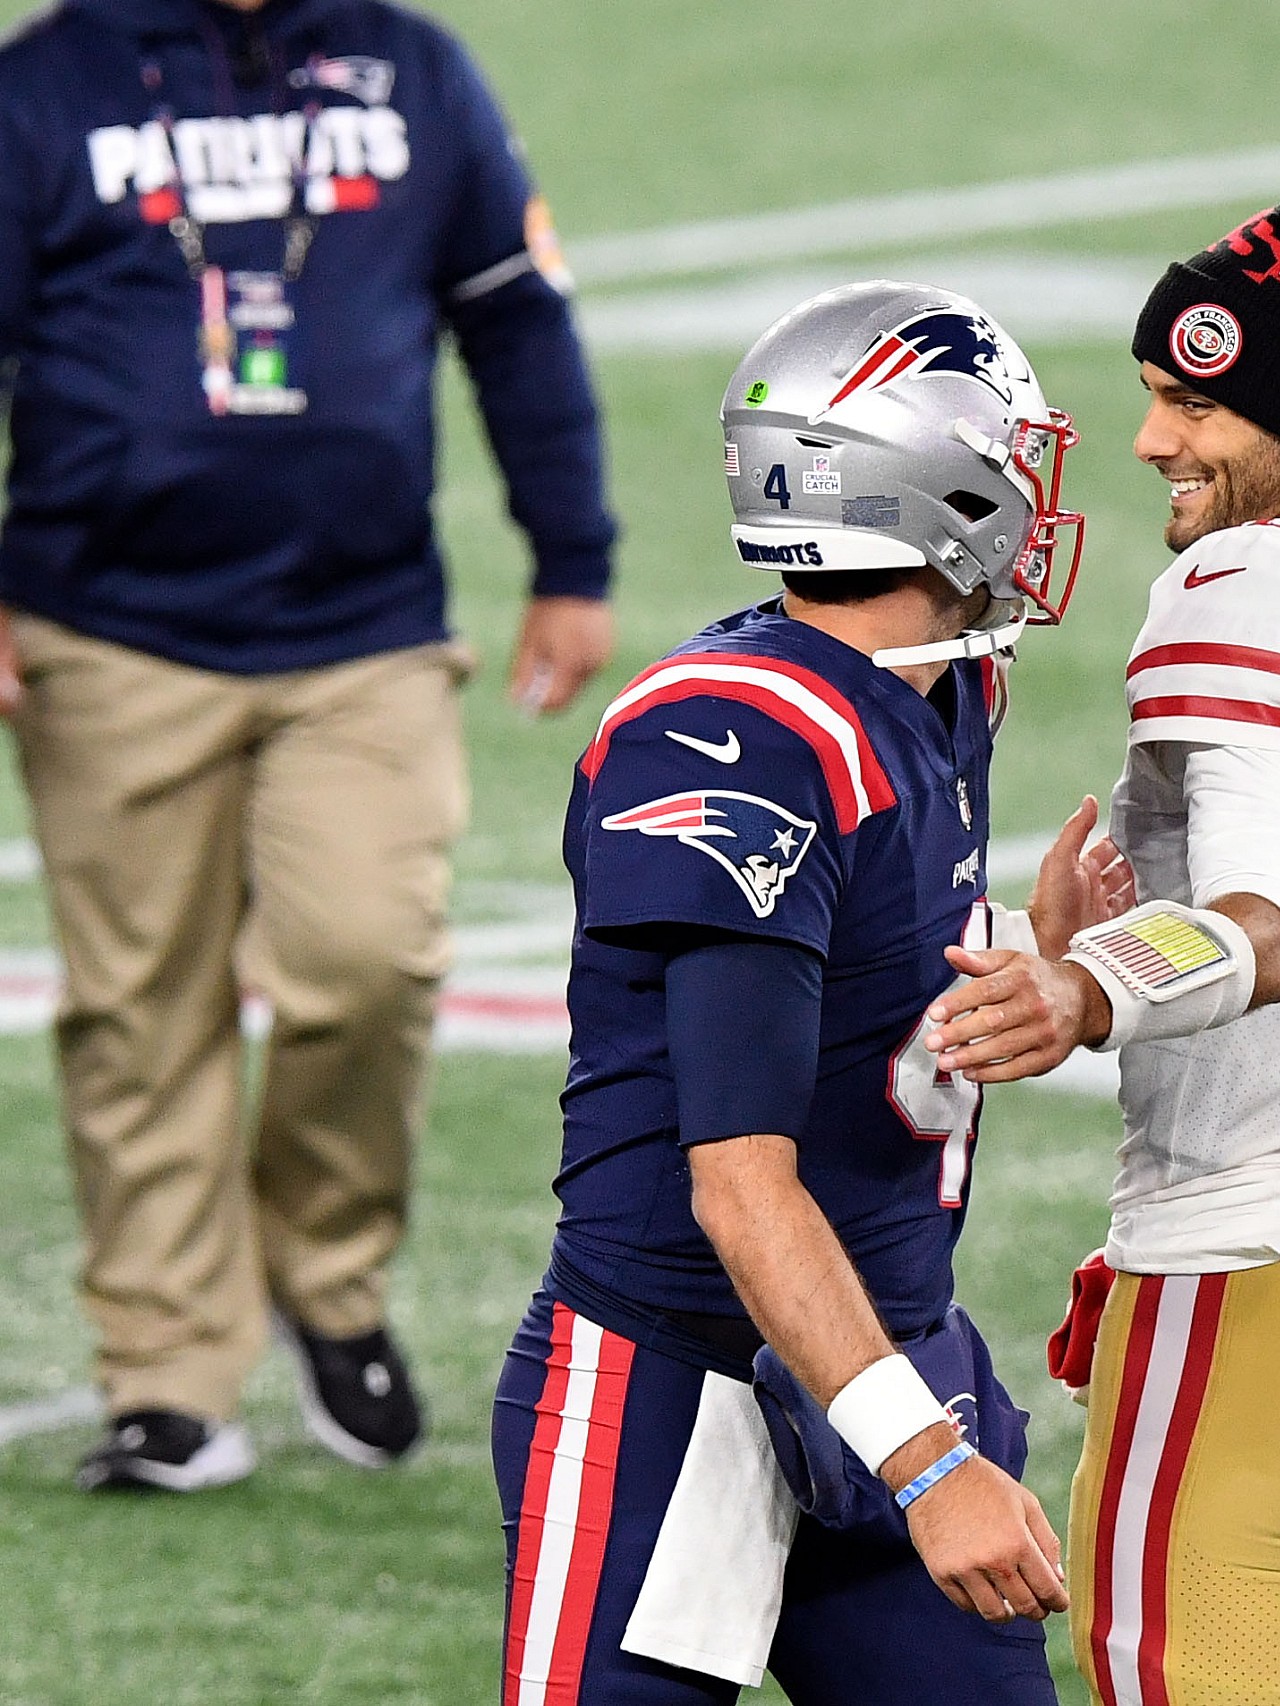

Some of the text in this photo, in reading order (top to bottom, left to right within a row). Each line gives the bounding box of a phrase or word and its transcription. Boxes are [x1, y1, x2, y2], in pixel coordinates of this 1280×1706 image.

[1183, 310, 1235, 352] SAN FRANCISCO
[763, 464, 791, 510] 4
[805, 481, 838, 490] CATCH
